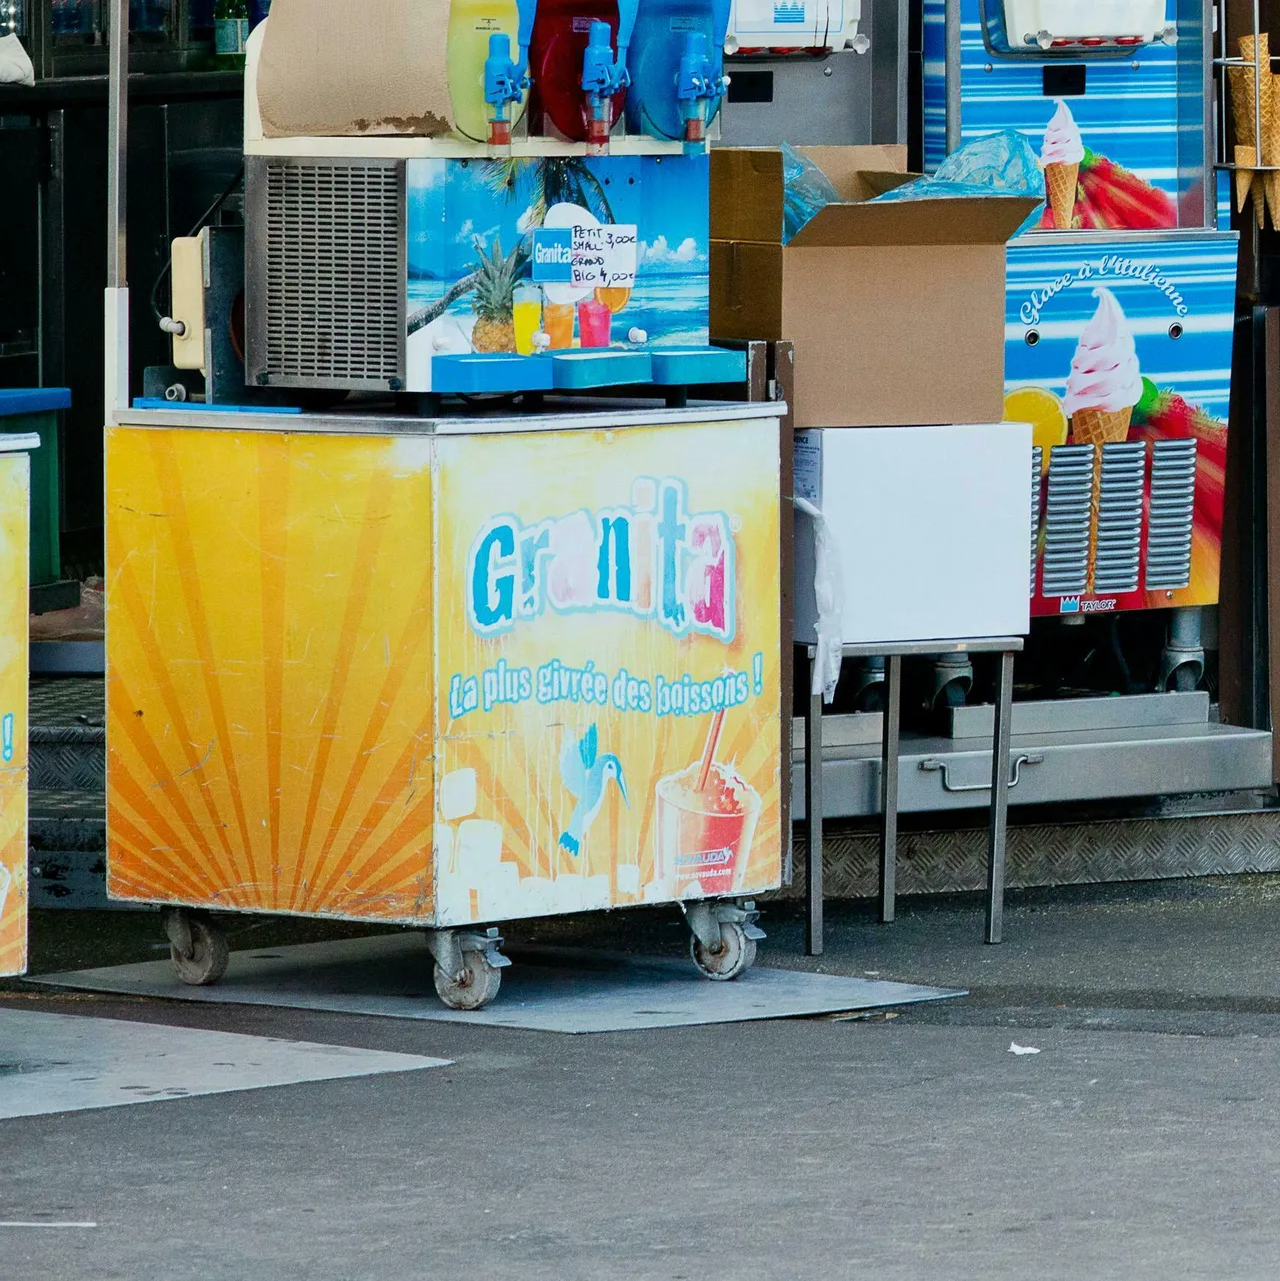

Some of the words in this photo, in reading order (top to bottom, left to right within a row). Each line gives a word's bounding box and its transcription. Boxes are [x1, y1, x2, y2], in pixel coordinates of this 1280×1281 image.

[572, 224, 603, 239] PETIT
[535, 241, 571, 264] Granita
[572, 269, 596, 282] BIG
[1019, 272, 1074, 325] Glace
[1077, 260, 1095, 281] à
[1099, 254, 1188, 317] l'italienne
[468, 476, 736, 644] Granita
[1081, 598, 1117, 612] TAYLOR
[449, 672, 479, 718] La
[482, 658, 532, 712] plus
[536, 658, 609, 705] givrée
[612, 667, 651, 711] des
[655, 670, 750, 718] boissons
